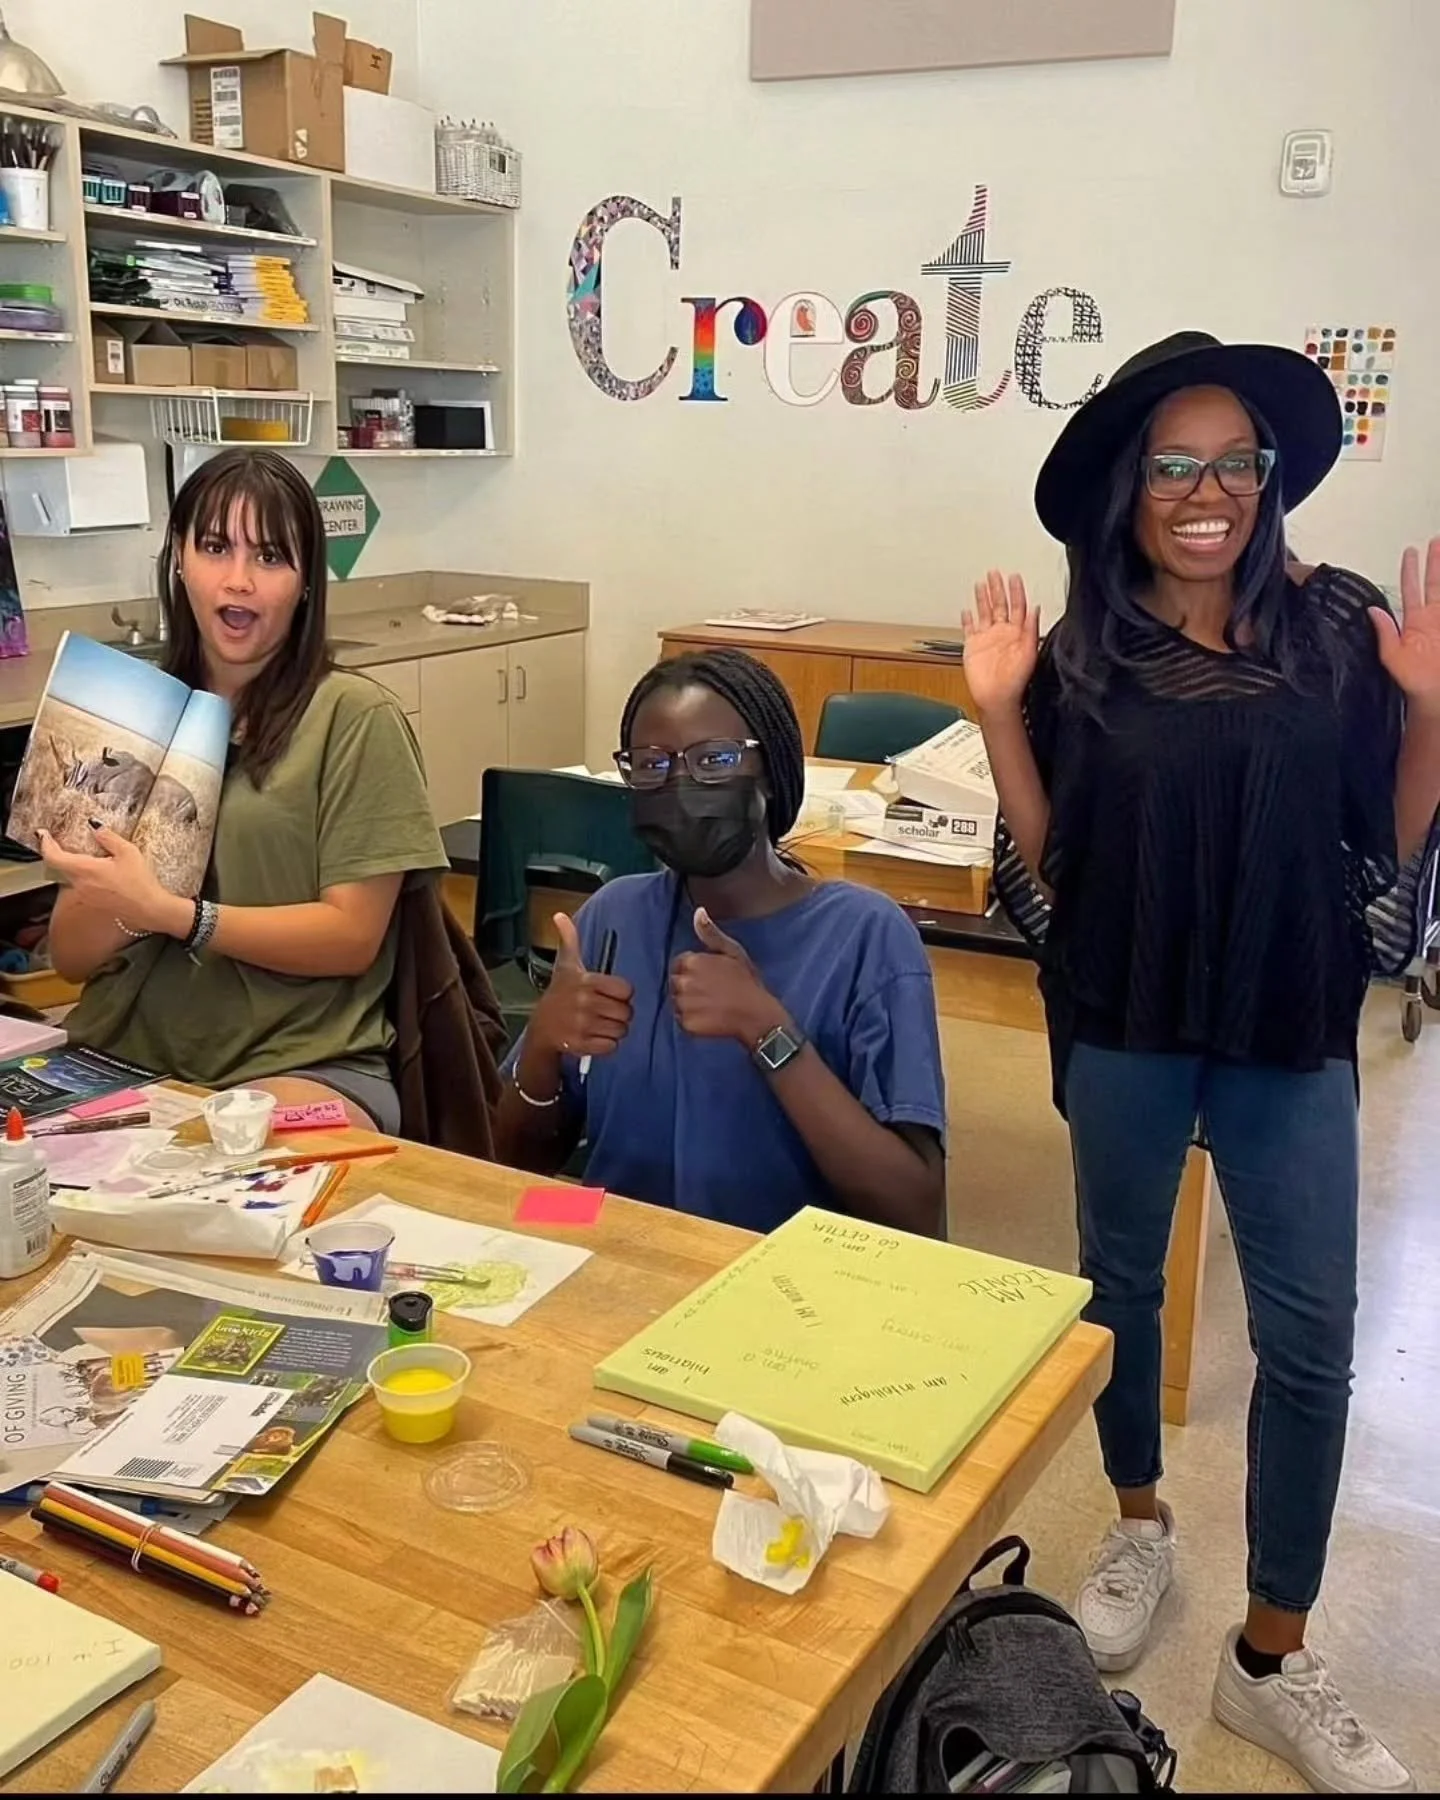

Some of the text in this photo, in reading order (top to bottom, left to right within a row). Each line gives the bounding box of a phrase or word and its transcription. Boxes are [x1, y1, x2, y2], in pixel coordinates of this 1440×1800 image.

[566, 184, 1105, 411] Create
[897, 824, 941, 839] scholar
[952, 820, 977, 835] 288
[957, 1269, 1051, 1296] ICONIC
[986, 1288, 1025, 1303] AM
[641, 1346, 711, 1375] hilarious
[646, 1361, 670, 1376] am
[921, 1376, 948, 1390] am
[839, 1385, 916, 1408] intelligent
[3, 1371, 28, 1445] OF GIVING
